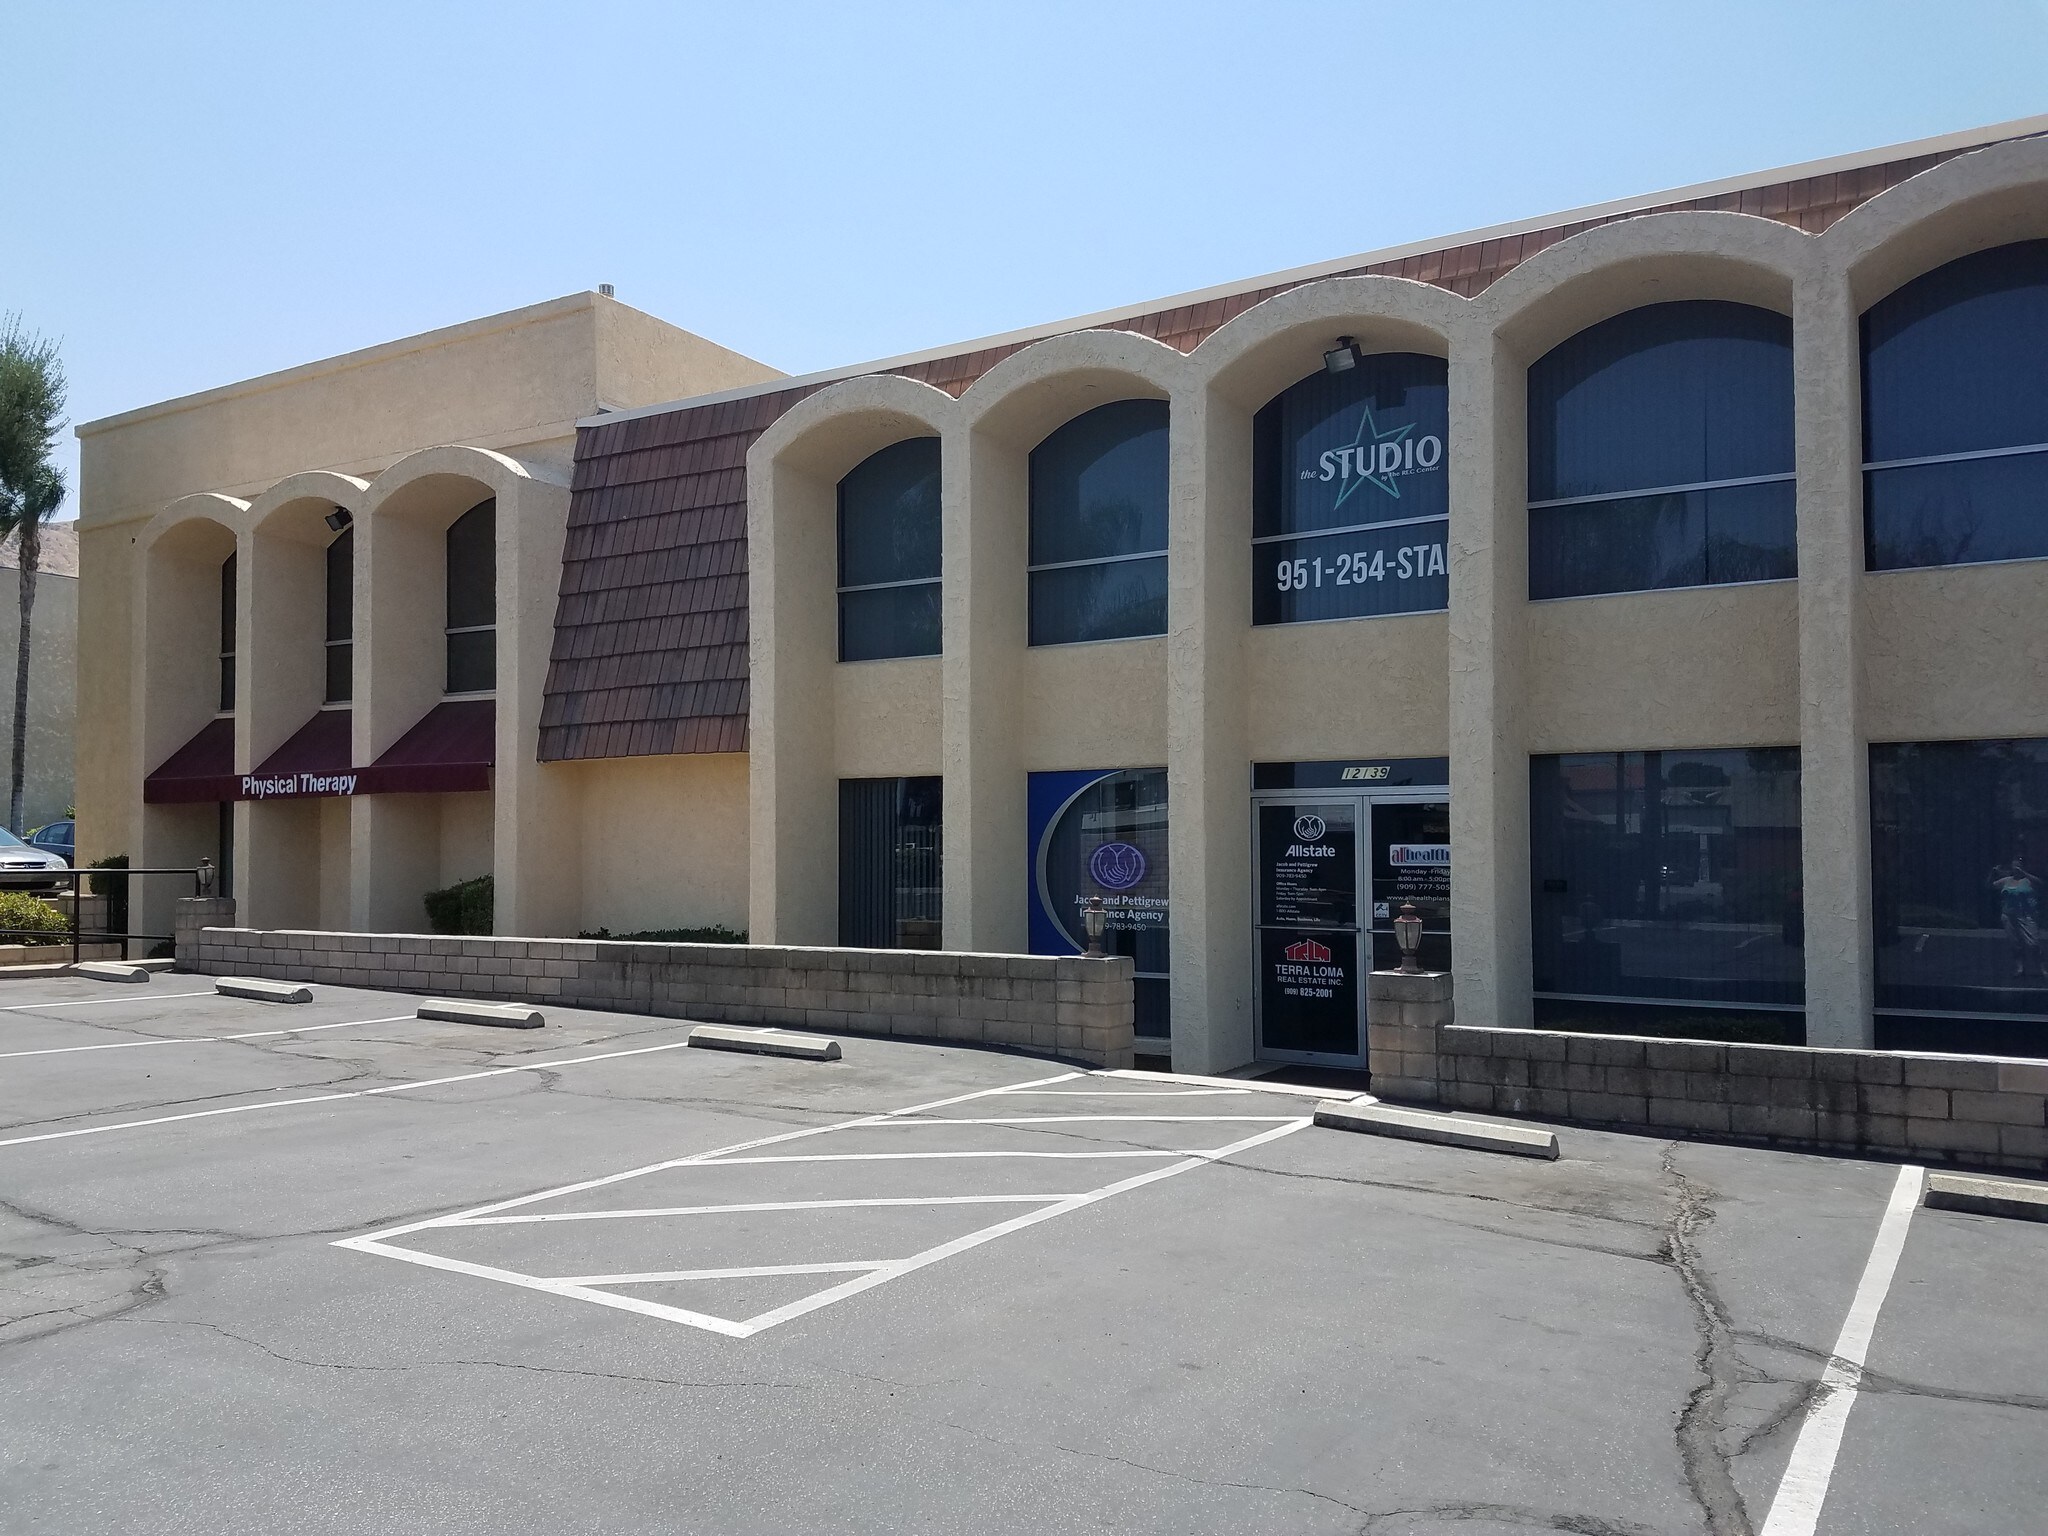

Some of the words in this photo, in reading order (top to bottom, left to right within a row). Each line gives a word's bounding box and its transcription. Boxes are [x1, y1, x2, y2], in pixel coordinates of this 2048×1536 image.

[1300, 469, 1318, 480] the
[1319, 435, 1442, 482] STUDIO
[1416, 465, 1440, 473] Center
[1277, 542, 1450, 592] 951-254-STA
[1344, 767, 1388, 779] 12139
[242, 774, 298, 799] Physical
[300, 773, 357, 796] Therapy
[1285, 844, 1336, 857] Allstate
[1400, 868, 1428, 876] Monday
[1102, 895, 1120, 905] and
[1122, 896, 1169, 907] Pettigrew
[1127, 909, 1164, 921] Agency
[1104, 922, 1147, 931] 9-783-9450
[1275, 964, 1311, 976] TERRA
[1313, 966, 1344, 978] LOMA
[1277, 975, 1297, 983] REAL
[1298, 977, 1327, 985] ESTATE
[1328, 978, 1344, 986] INC.
[1284, 987, 1299, 996] (909)
[1300, 987, 1333, 998] 825-2001
